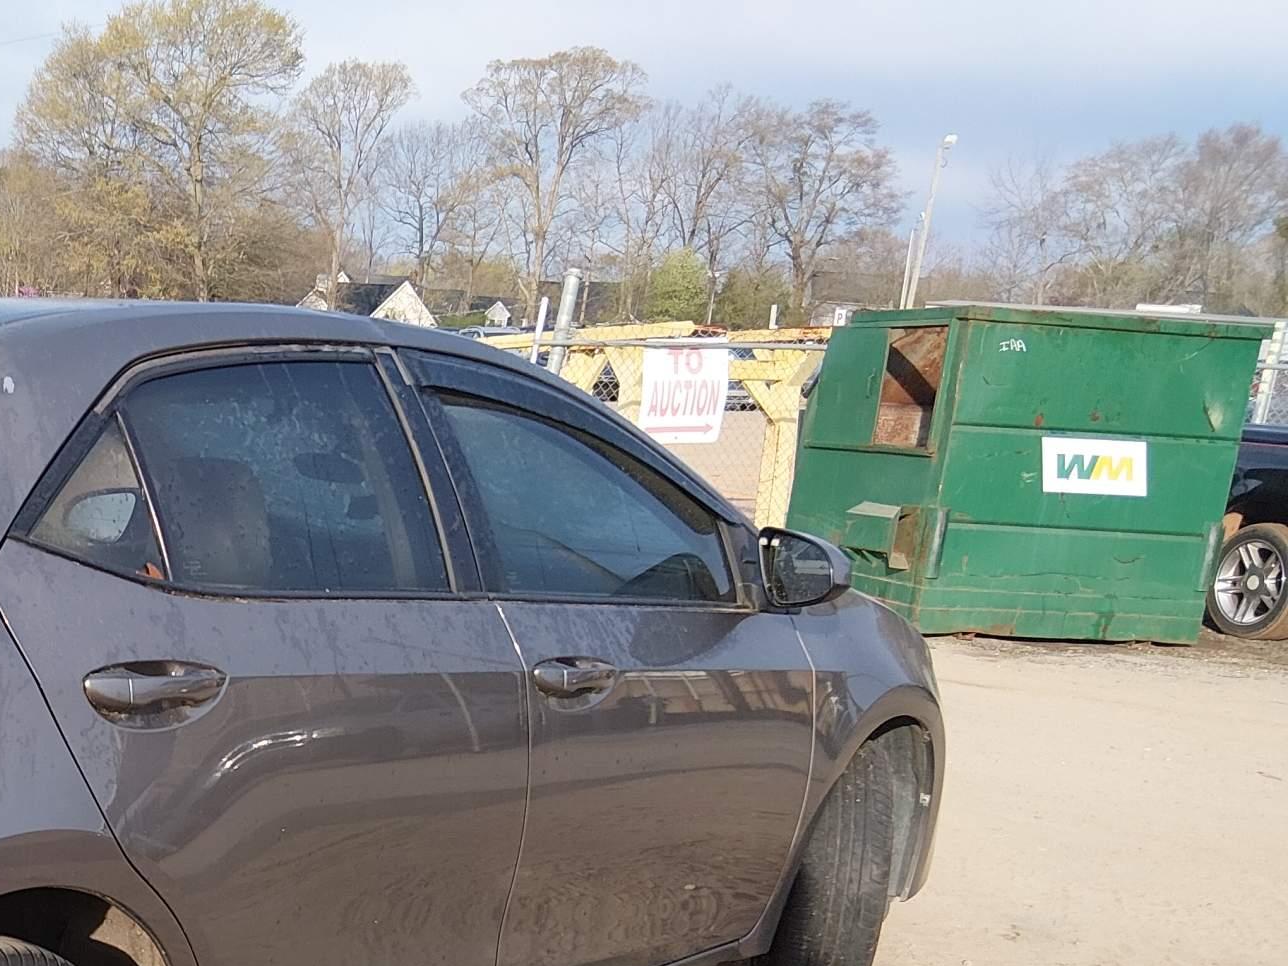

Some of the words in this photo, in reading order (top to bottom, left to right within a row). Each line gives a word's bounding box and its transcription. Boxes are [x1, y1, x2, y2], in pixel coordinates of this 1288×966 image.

[999, 338, 1027, 352] IAA
[667, 346, 703, 375] TO
[647, 379, 721, 416] AUCTION
[1055, 453, 1134, 481] WM
